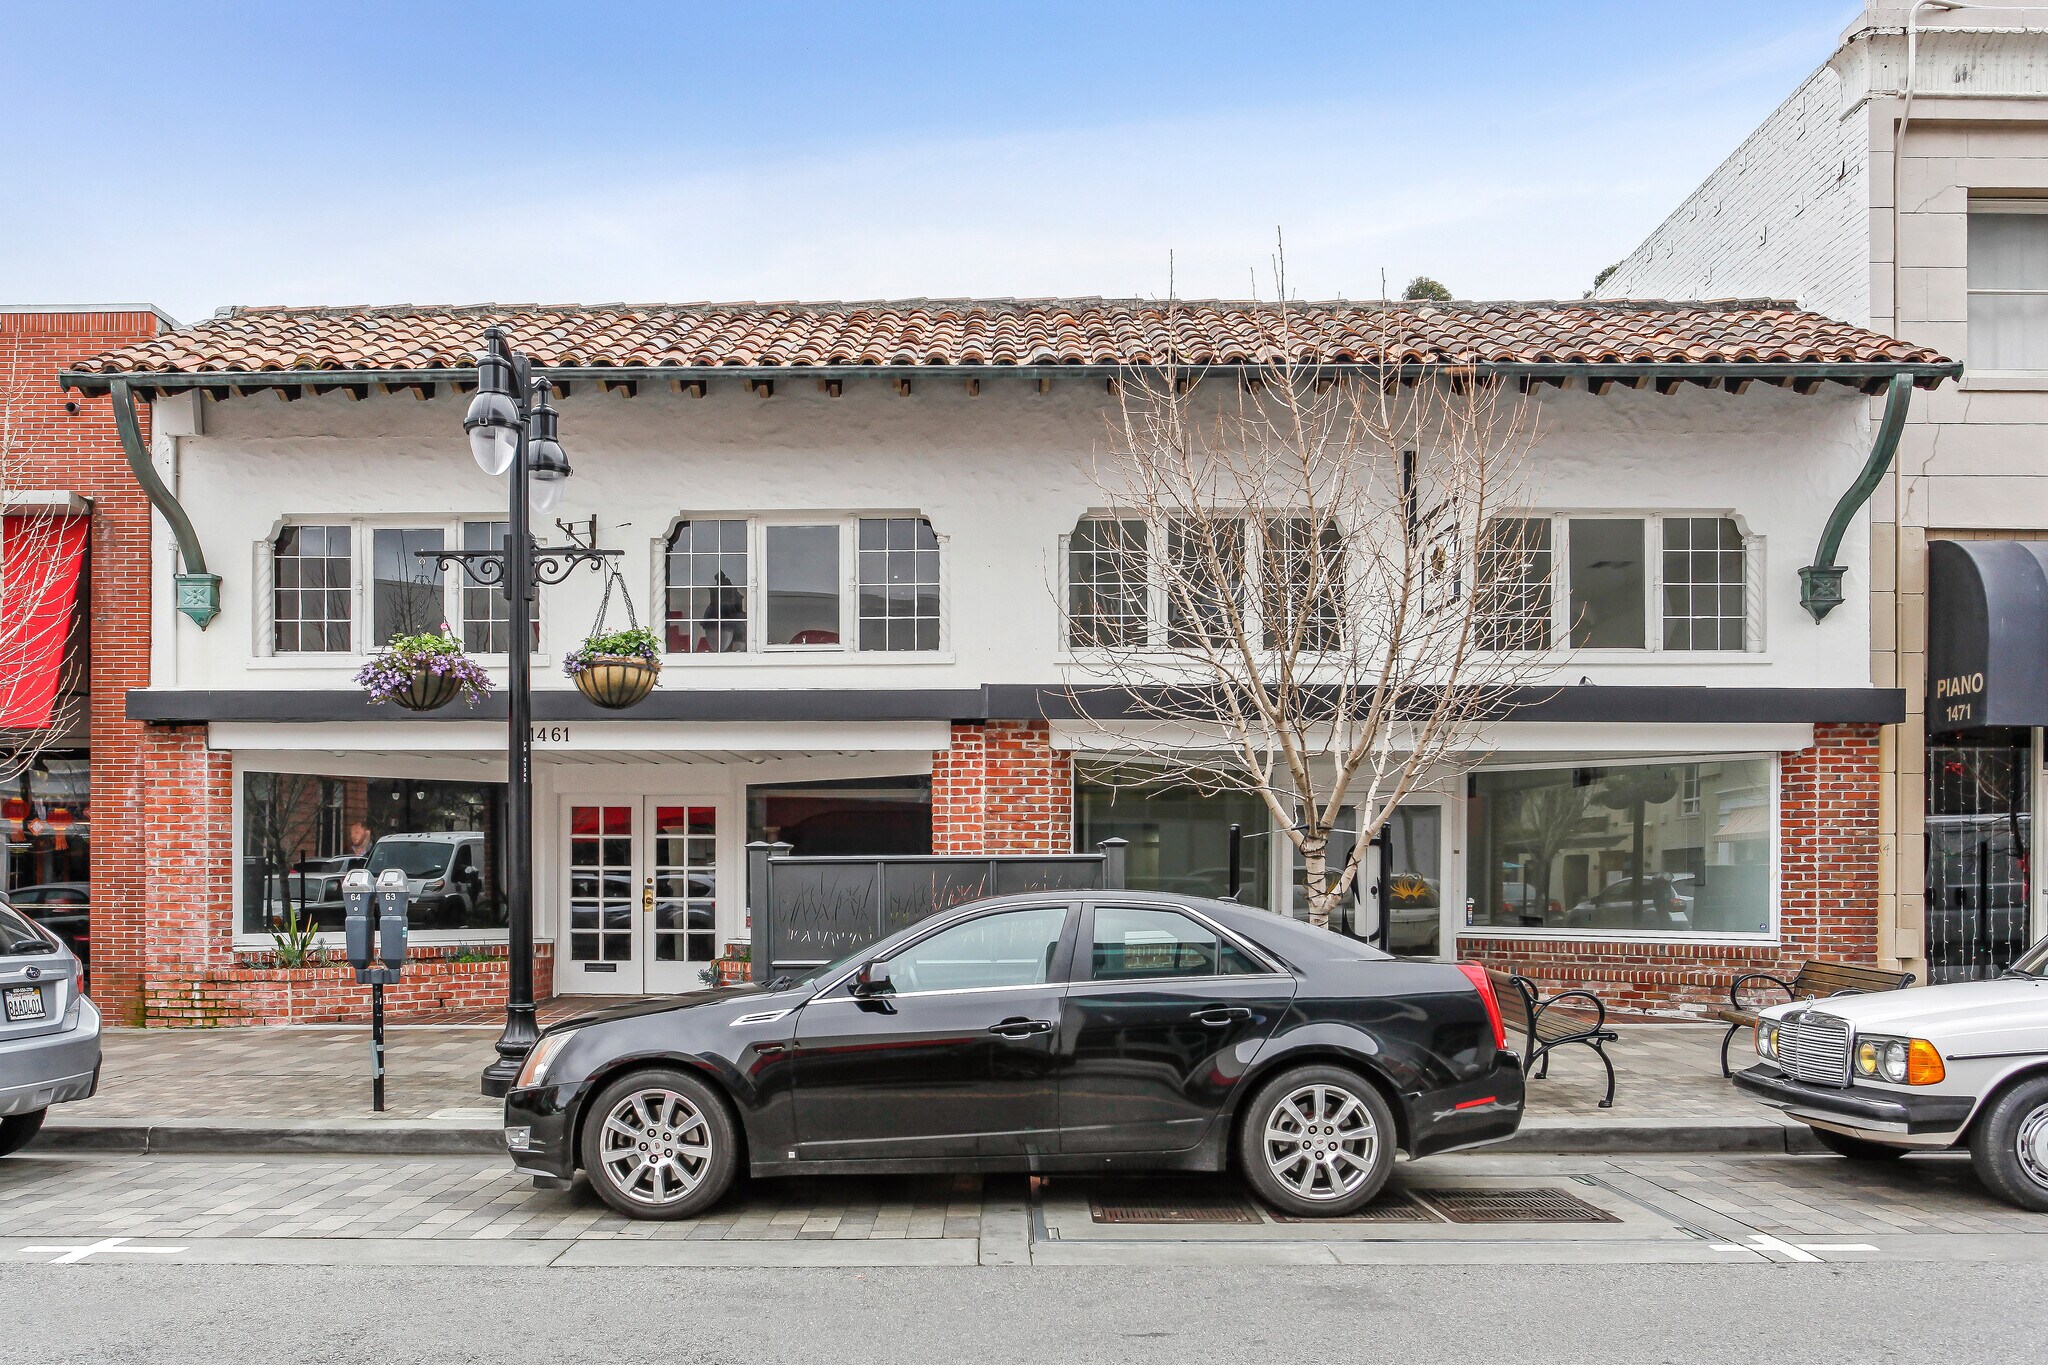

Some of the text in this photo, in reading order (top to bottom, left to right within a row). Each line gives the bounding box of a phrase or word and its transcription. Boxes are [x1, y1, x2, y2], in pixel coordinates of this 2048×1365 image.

[1937, 672, 1984, 699] PIANO
[1946, 703, 1971, 722] 1471
[530, 726, 570, 742] 1461
[350, 893, 361, 901] 64
[385, 892, 396, 901] 63
